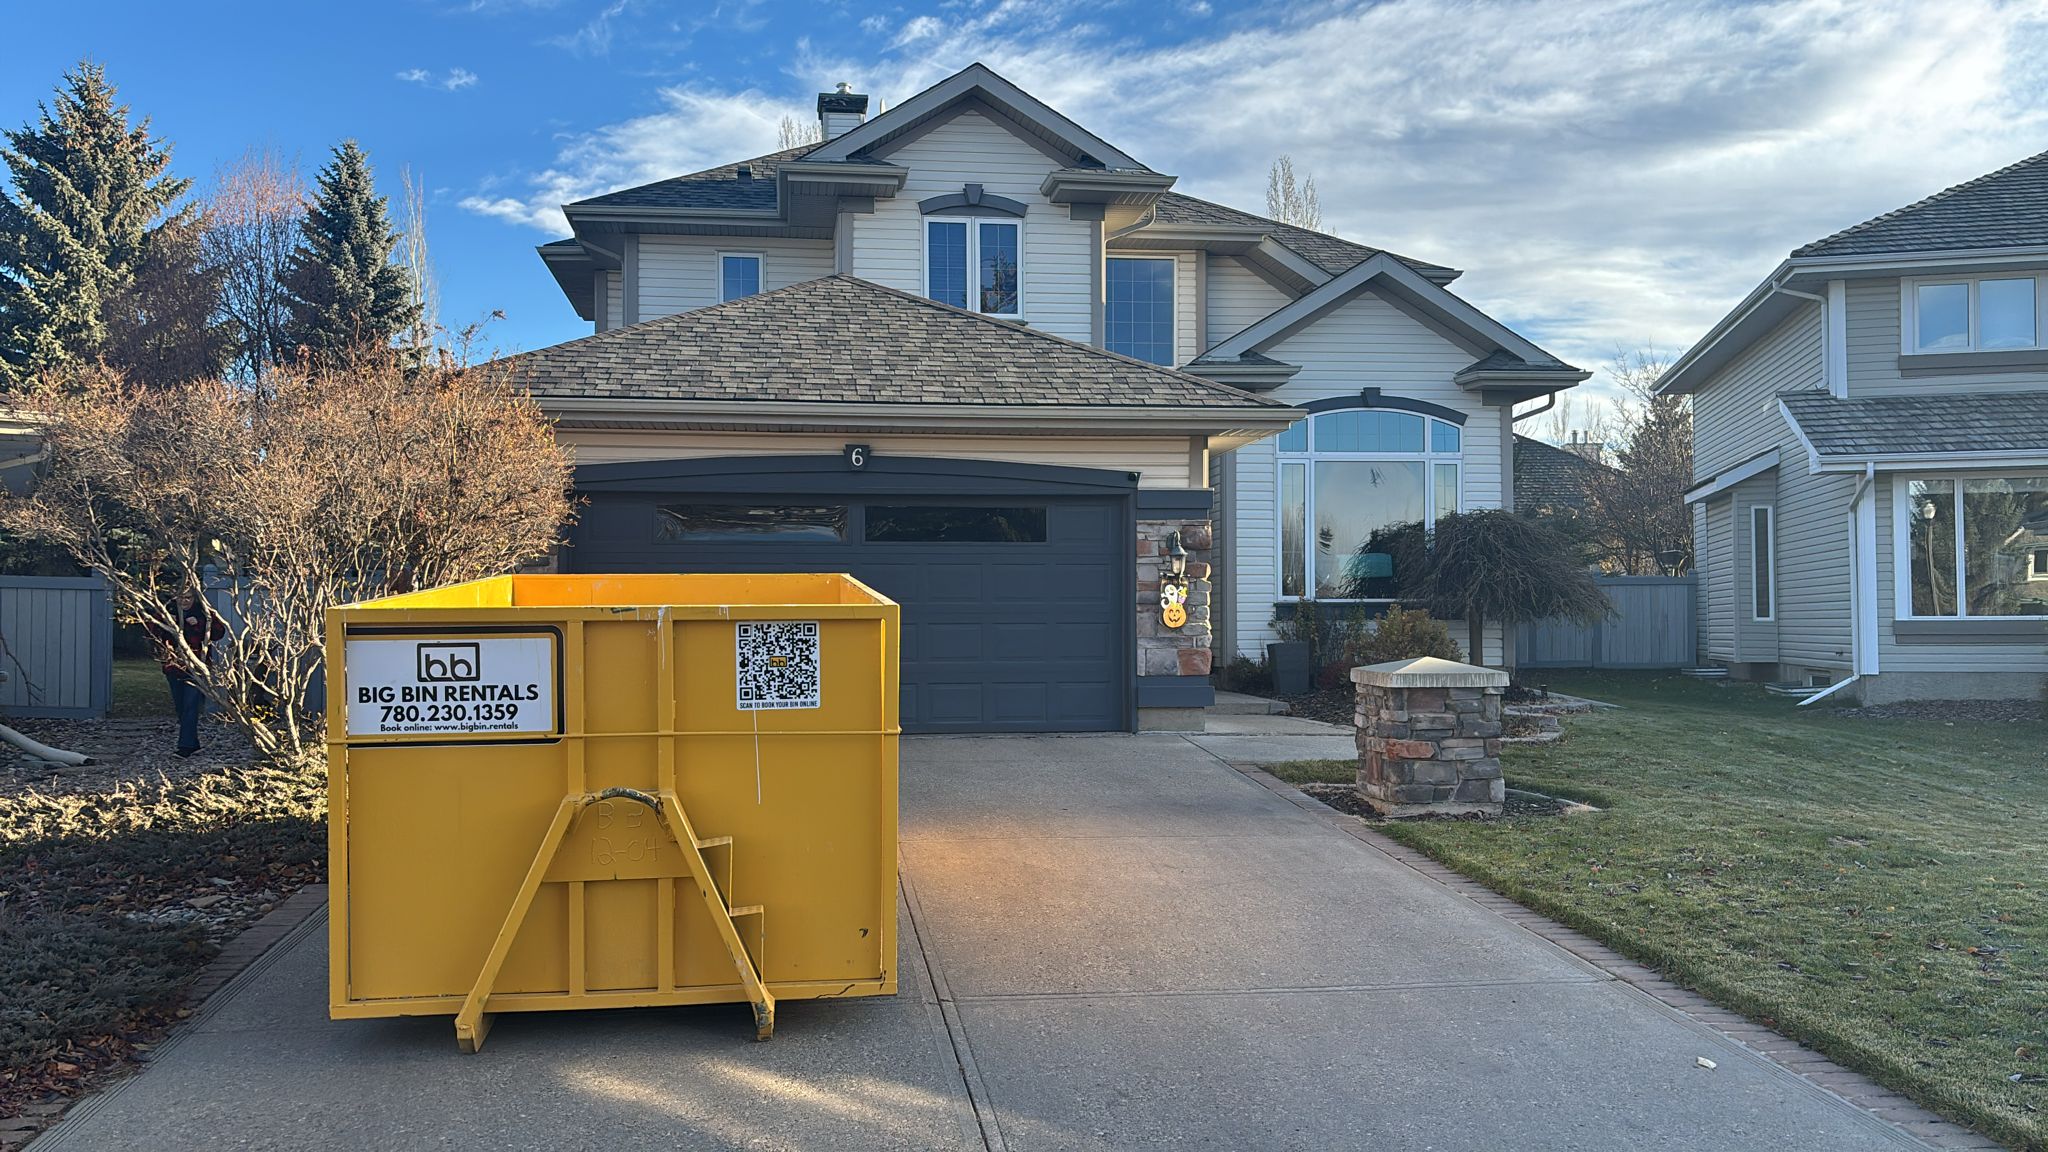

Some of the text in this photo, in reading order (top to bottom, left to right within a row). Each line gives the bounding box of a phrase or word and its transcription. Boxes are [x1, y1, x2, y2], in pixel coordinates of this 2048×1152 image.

[851, 447, 864, 467] 6
[358, 684, 539, 703] BIG BIN RENTALS
[380, 704, 519, 722] 780.230.1359
[380, 721, 519, 733] Book online: www.bigbin.rentals
